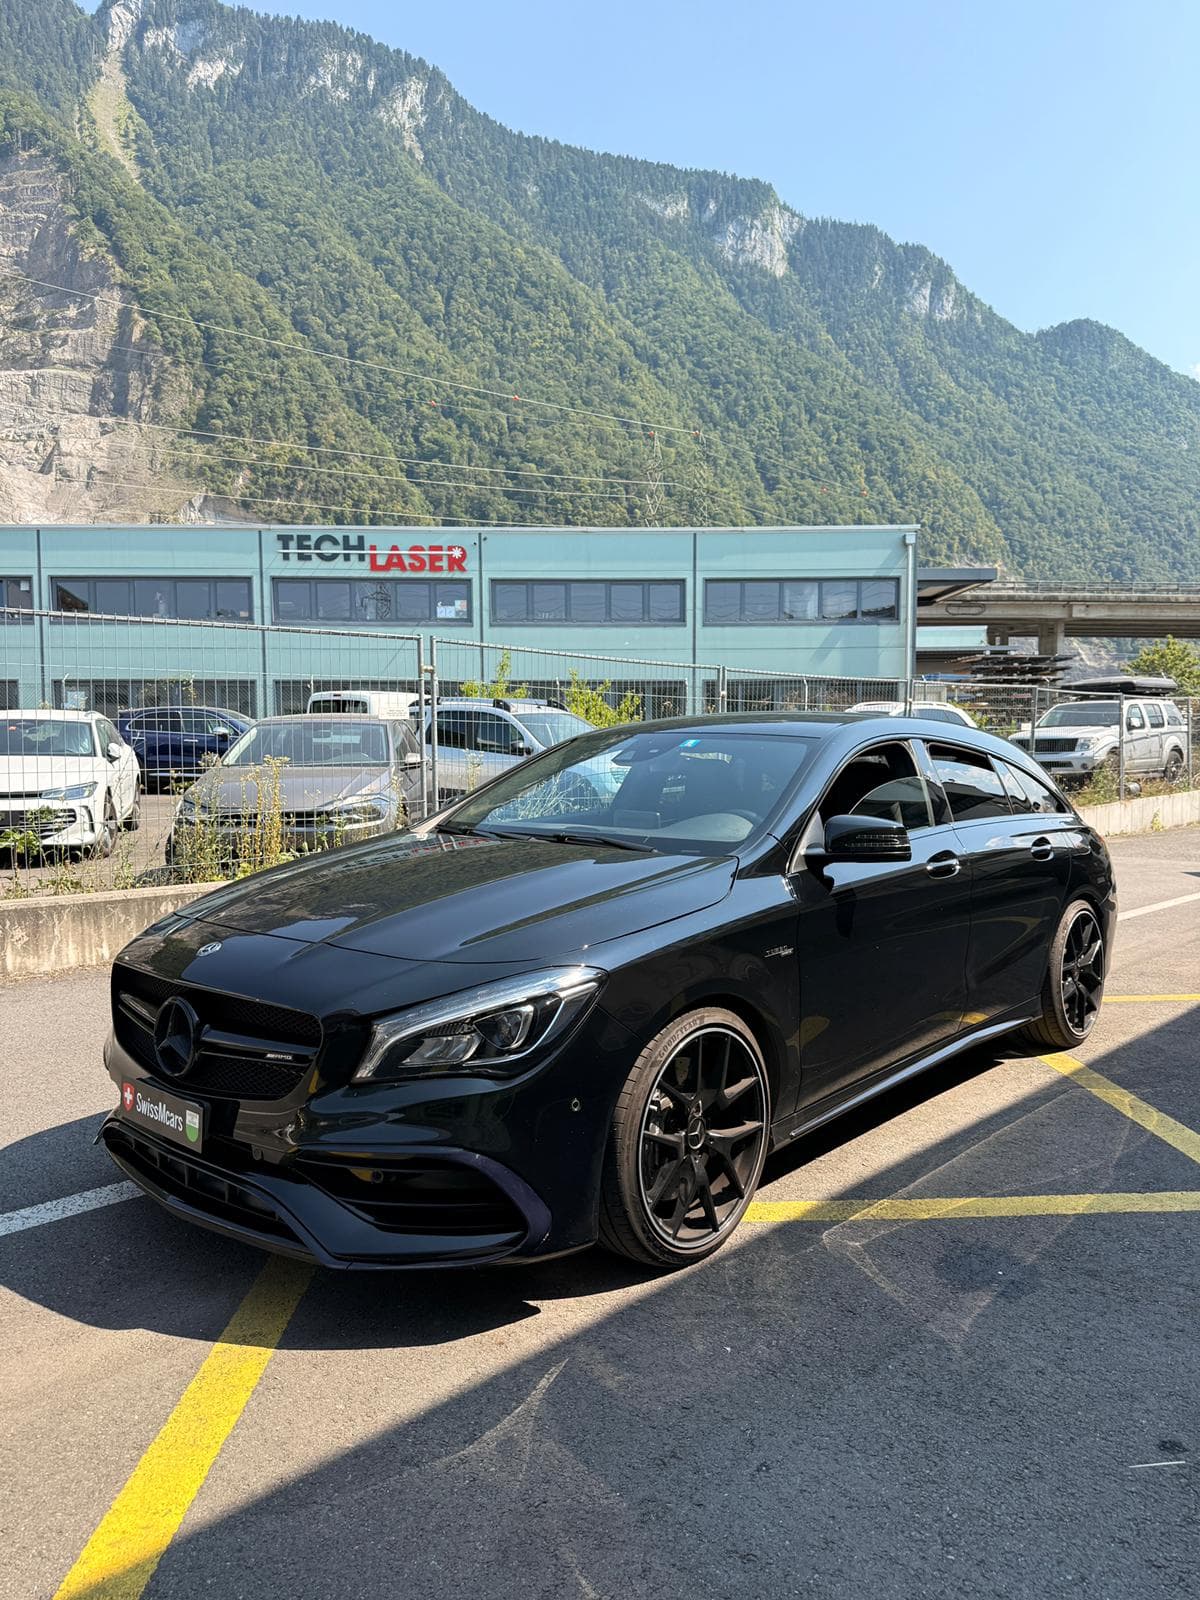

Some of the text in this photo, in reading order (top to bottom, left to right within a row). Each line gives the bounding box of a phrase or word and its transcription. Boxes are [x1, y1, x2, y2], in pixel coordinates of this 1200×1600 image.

[277, 534, 468, 572] TECH LASER
[136, 1092, 183, 1132] SwissMcars
